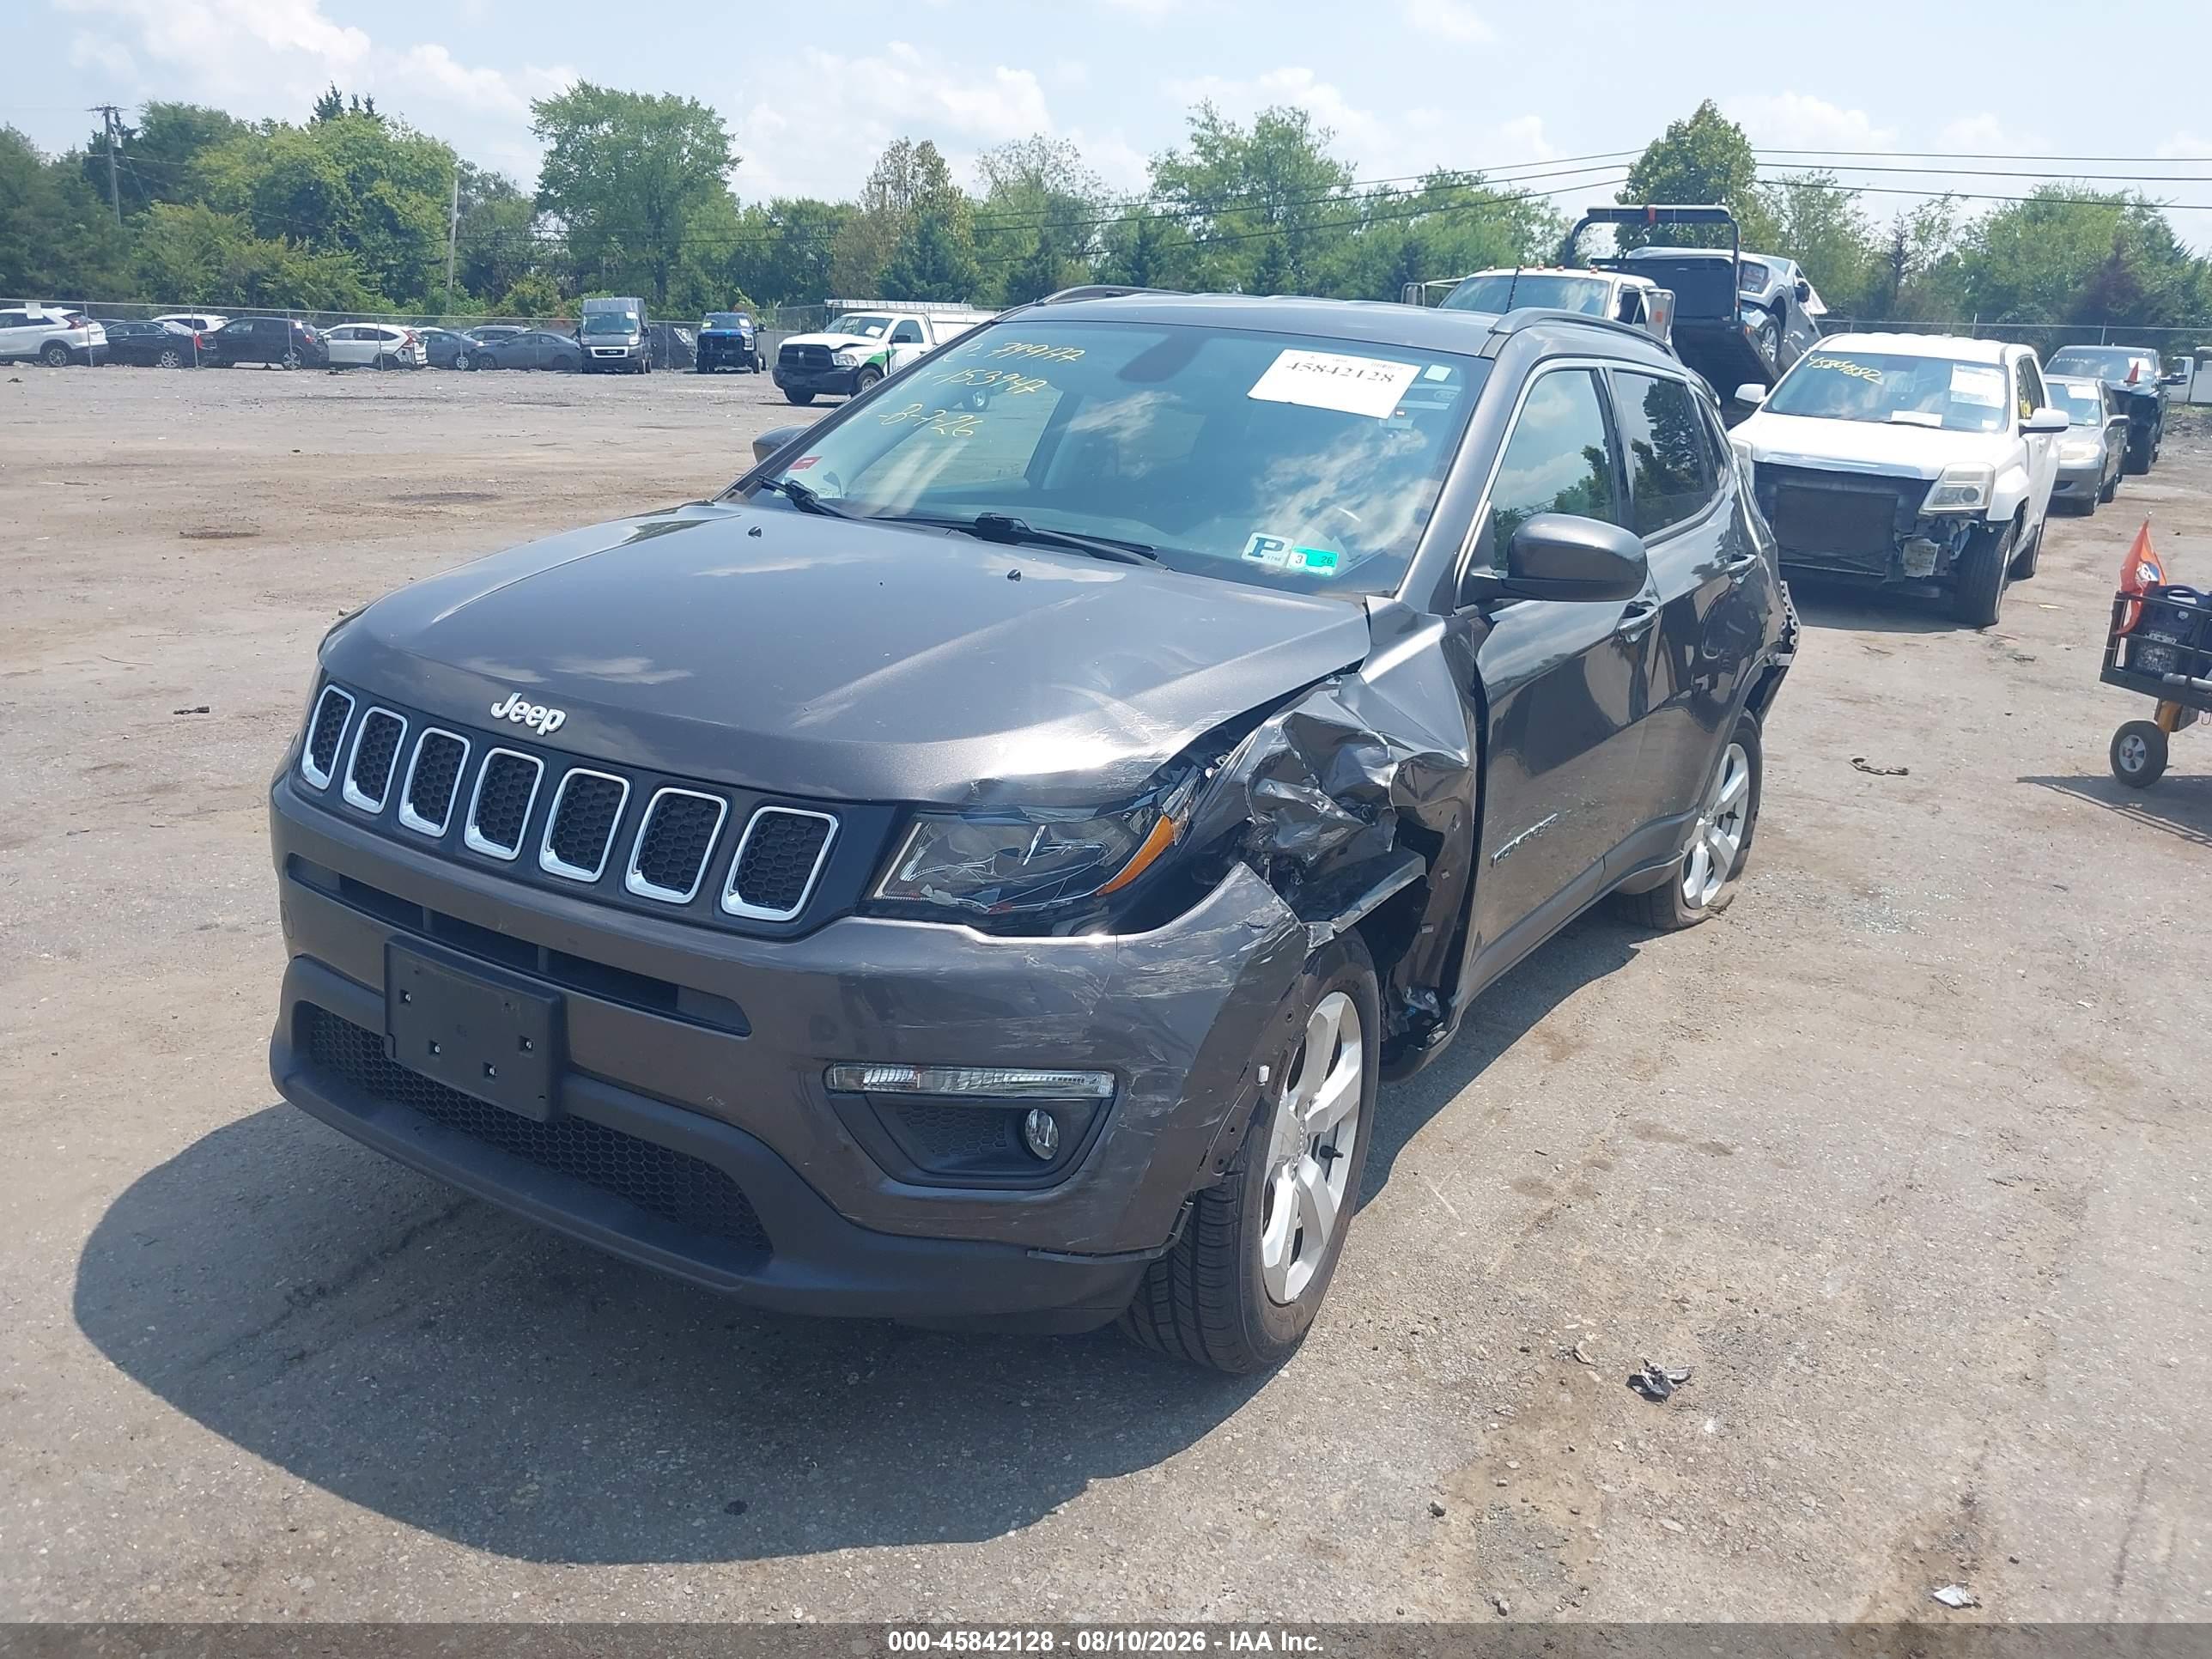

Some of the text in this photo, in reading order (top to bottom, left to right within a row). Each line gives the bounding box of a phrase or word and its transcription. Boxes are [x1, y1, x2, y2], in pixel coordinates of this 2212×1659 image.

[1285, 361, 1395, 383] 45842128
[1248, 537, 1285, 558] P
[1295, 555, 1334, 565] 3 26
[490, 692, 566, 736] Jeep
